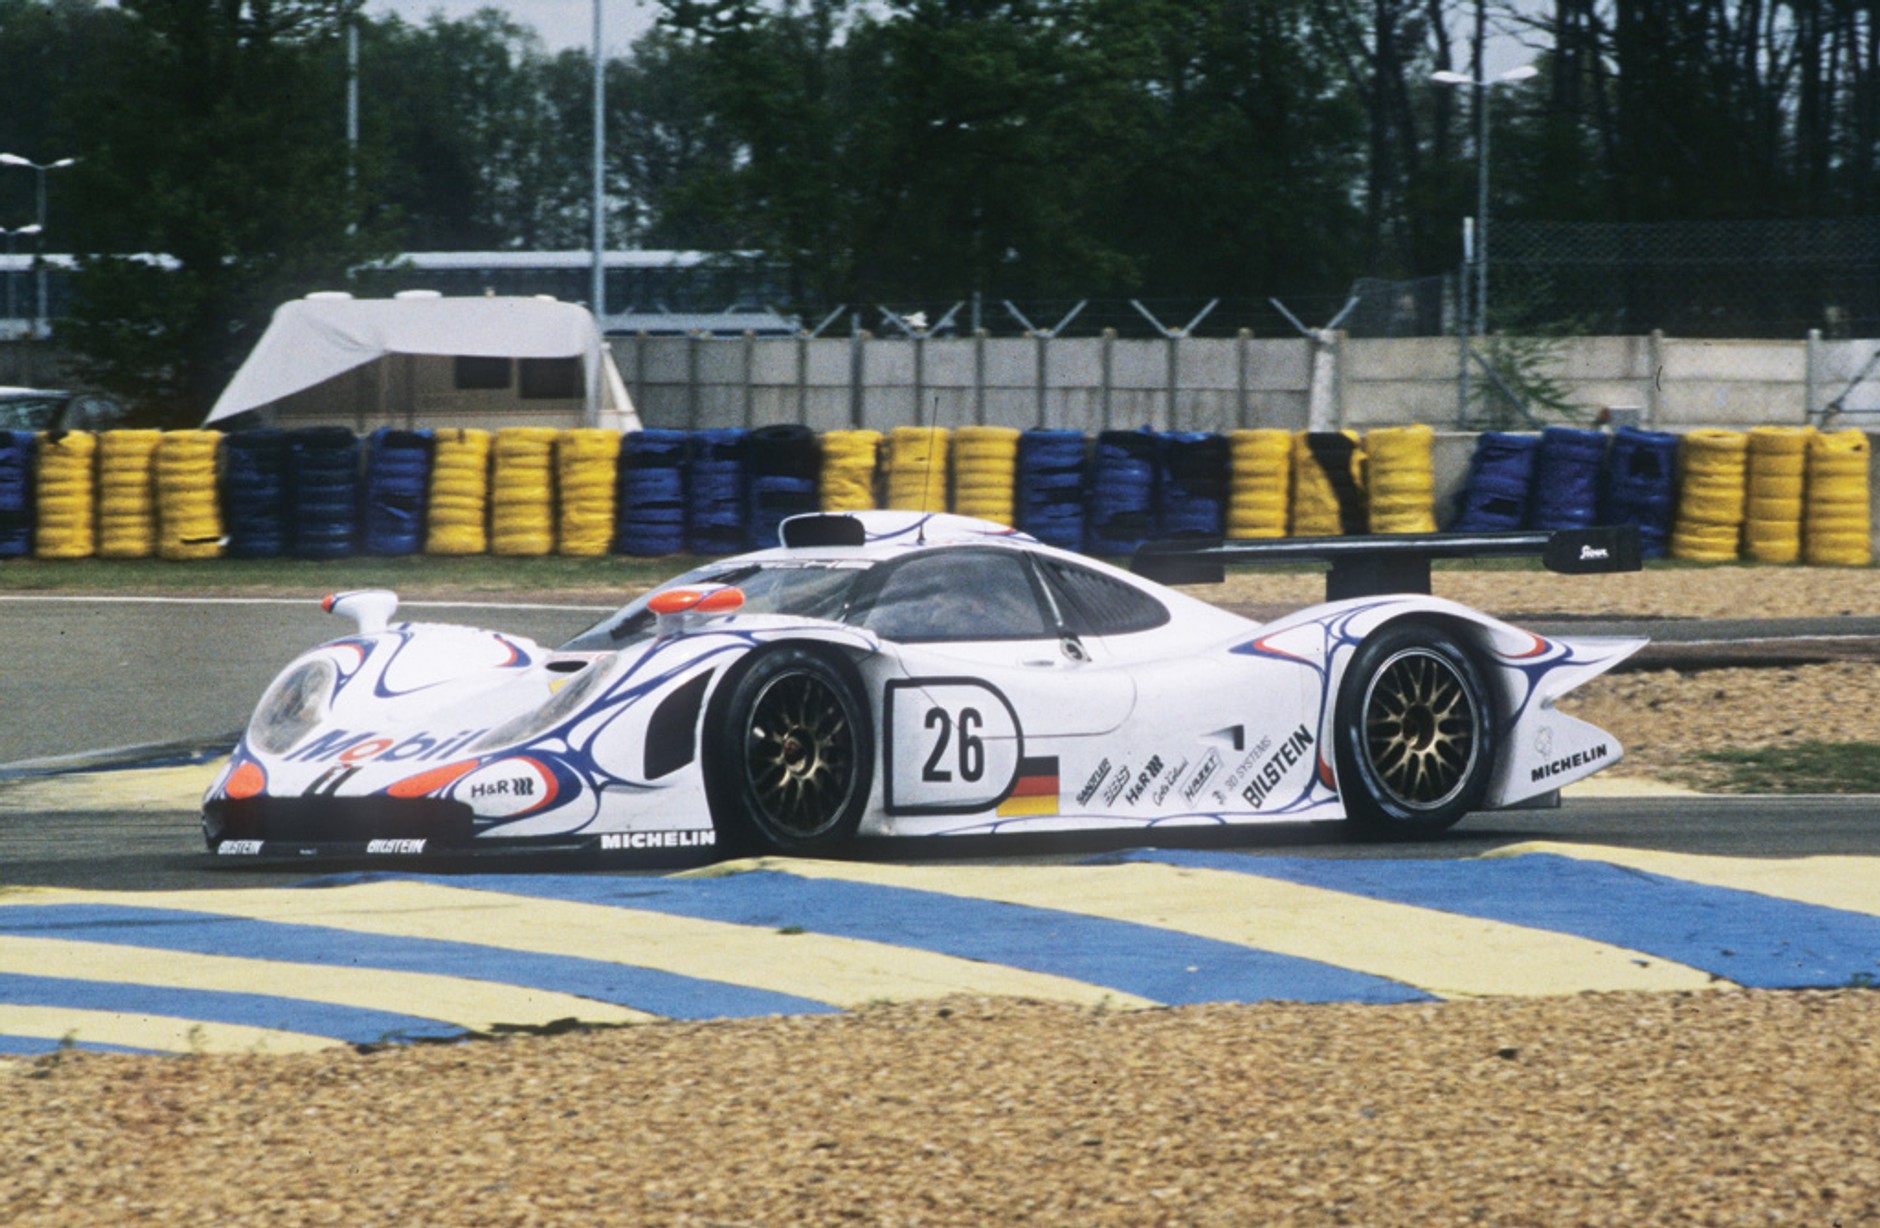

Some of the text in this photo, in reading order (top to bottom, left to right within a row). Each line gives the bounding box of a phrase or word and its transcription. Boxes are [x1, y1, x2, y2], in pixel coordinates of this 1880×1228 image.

[281, 728, 492, 762] Mobil
[921, 706, 985, 783] 26
[1236, 735, 1272, 778] SYSTEMS
[1242, 723, 1314, 809] BILSTEIN
[1531, 743, 1607, 783] MICHELIN
[471, 779, 510, 798] H&R
[1125, 772, 1151, 806] H&R
[366, 838, 427, 853] BILSTEIN
[601, 830, 716, 849] MICHELIN
